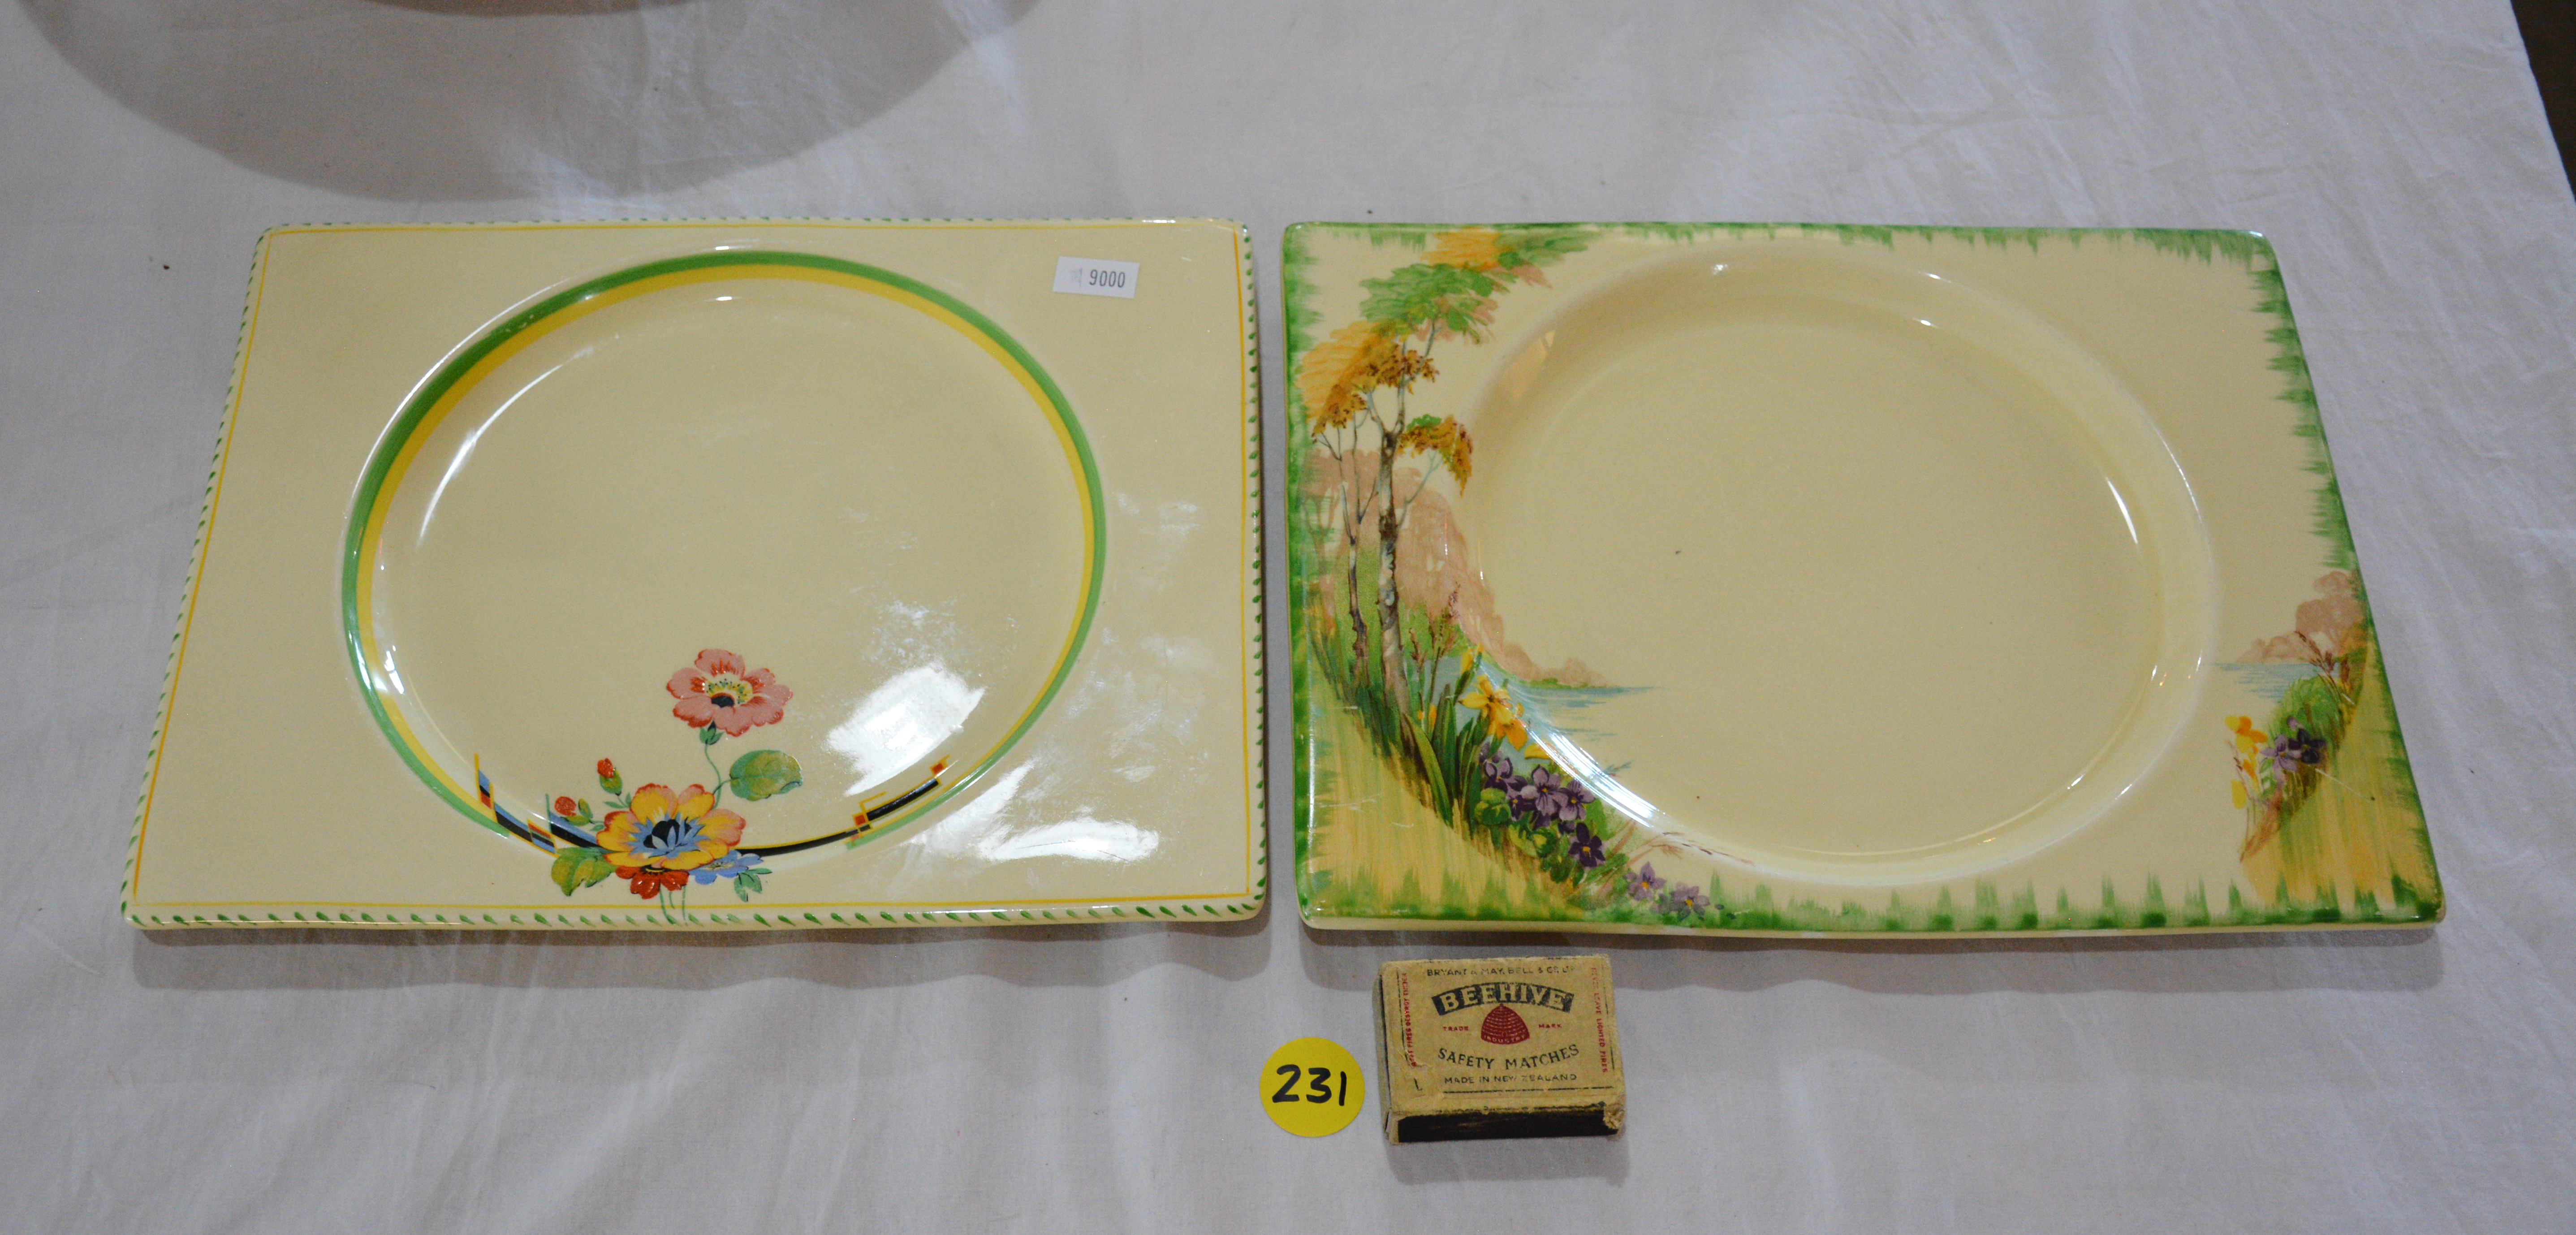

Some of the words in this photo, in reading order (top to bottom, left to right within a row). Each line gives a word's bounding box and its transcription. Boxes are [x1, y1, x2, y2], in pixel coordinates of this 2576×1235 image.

[1089, 269, 1125, 288] 9000
[1440, 984, 1567, 1012] BEEHIVE
[1484, 1035, 1525, 1043] INDUSTRY
[1597, 1018, 1606, 1047] LIGHTED
[1438, 1048, 1494, 1069] SAFETY
[1505, 1044, 1579, 1070] MATCHES
[1599, 1050, 1609, 1073] FIRES
[1272, 1064, 1347, 1106] 231
[1522, 1074, 1577, 1082] ZEALAND
